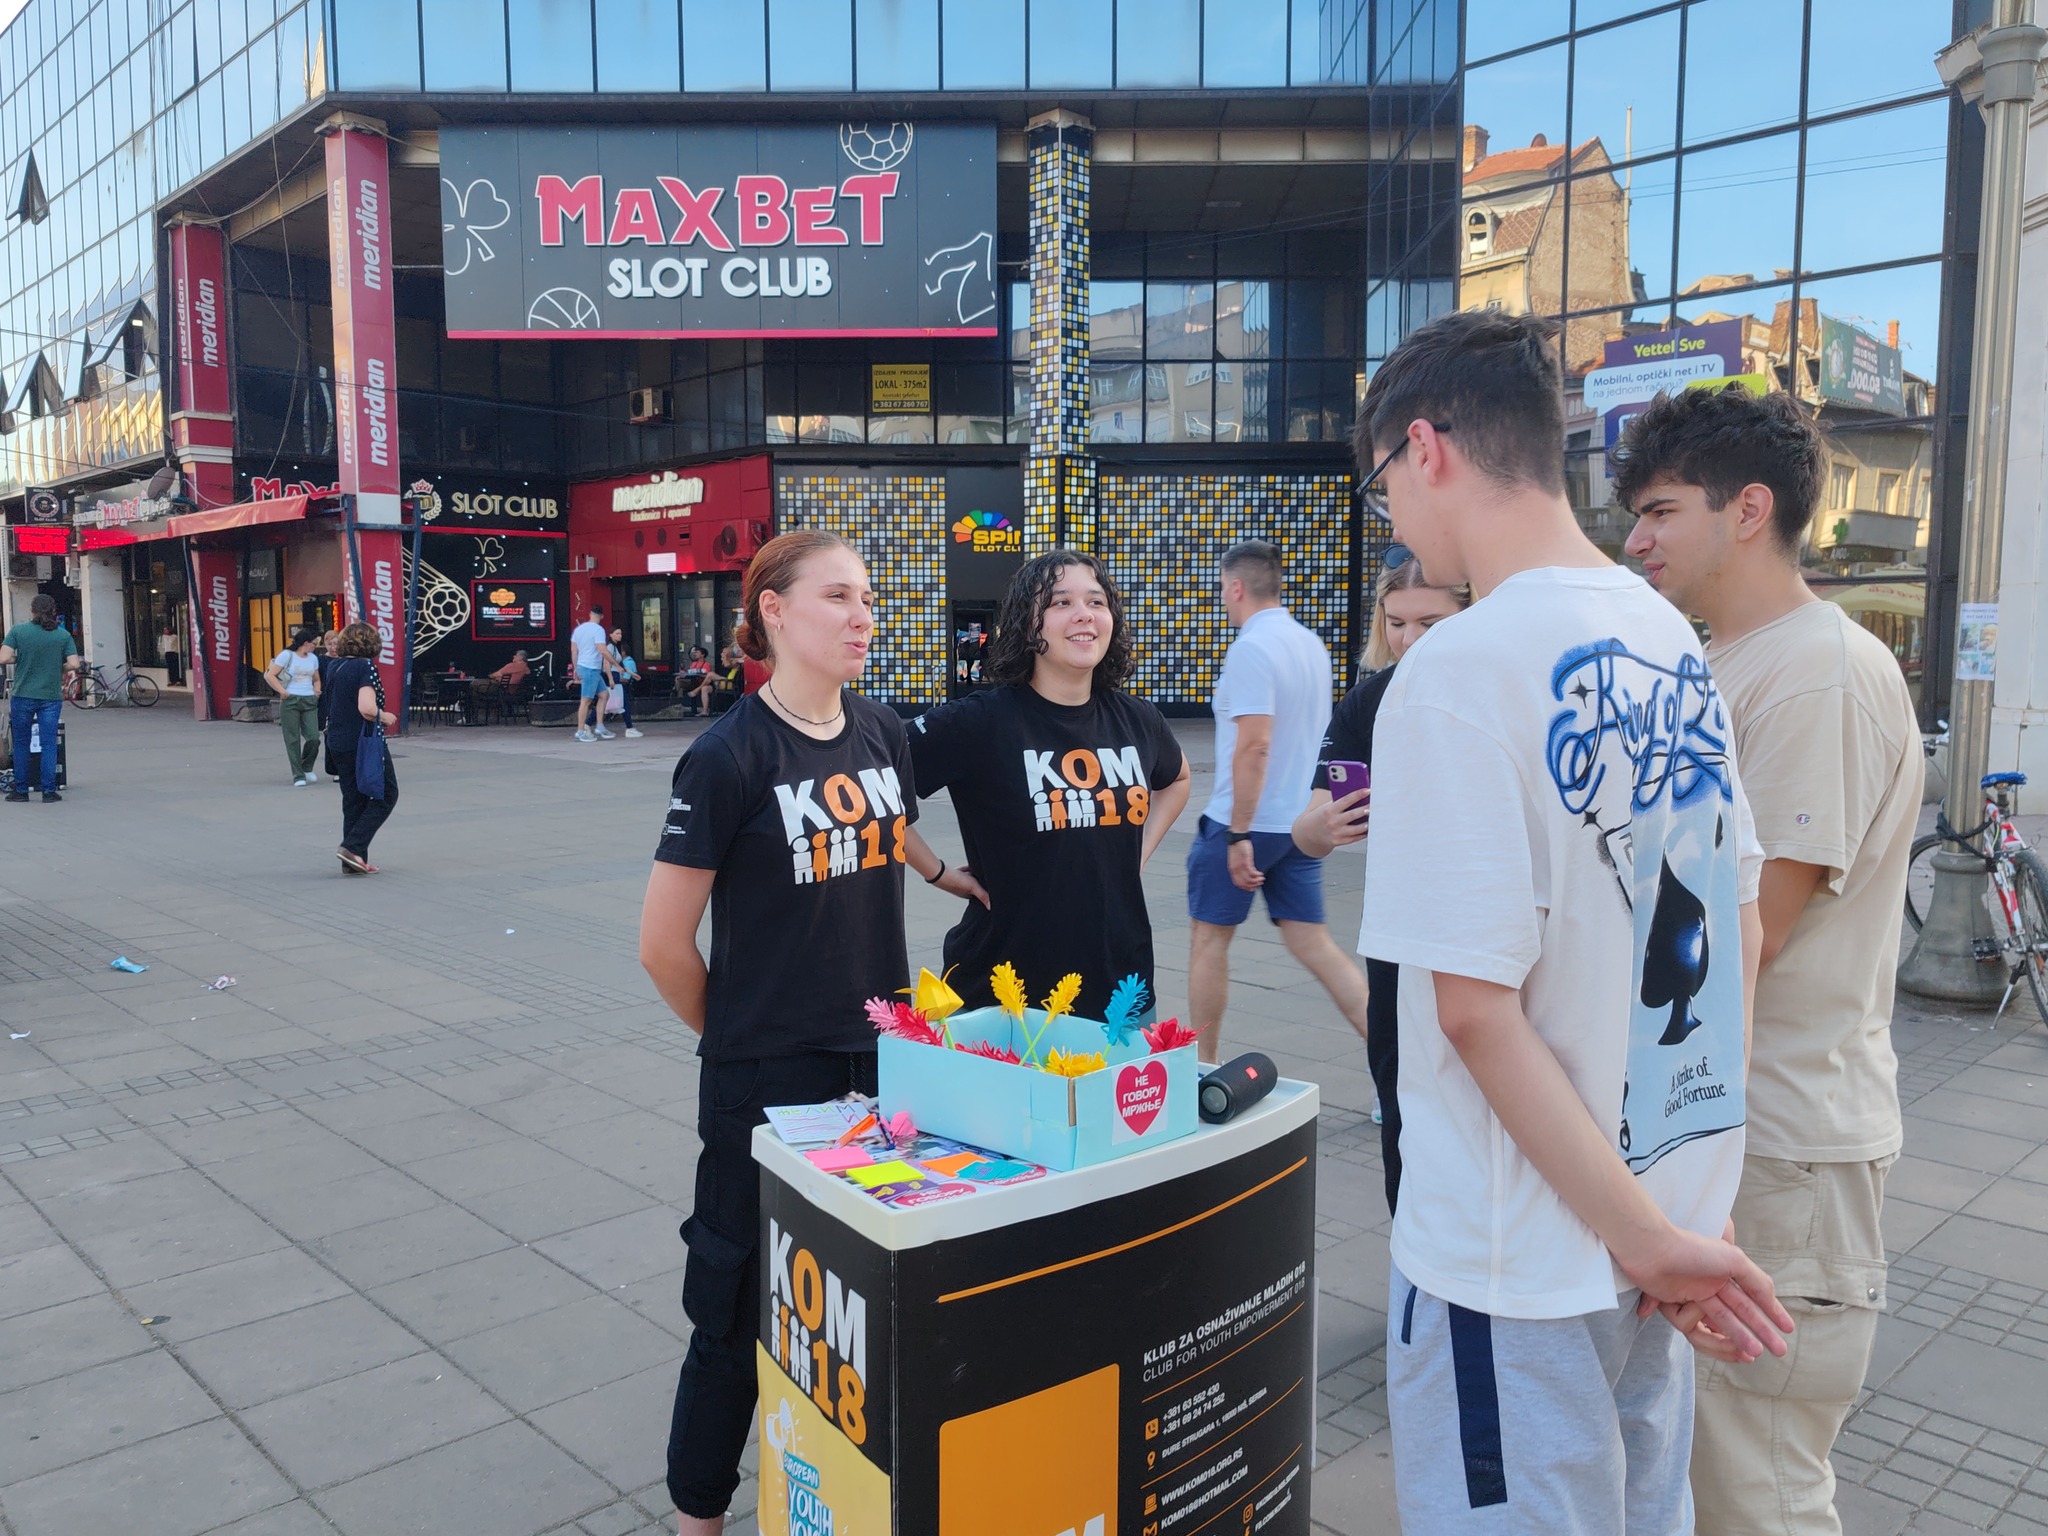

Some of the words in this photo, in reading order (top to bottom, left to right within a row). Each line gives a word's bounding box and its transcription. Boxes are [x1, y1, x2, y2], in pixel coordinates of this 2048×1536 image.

[330, 179, 345, 288] meridian
[355, 179, 381, 291] meridian
[535, 172, 900, 252] MAXBET
[607, 257, 709, 299] SLOT
[721, 256, 833, 299] CLUB
[176, 278, 188, 367] meridian
[196, 278, 218, 368] meridian
[1633, 339, 1675, 358] Yettel
[1679, 337, 1706, 352] Sve
[875, 380, 898, 389] LOKAL
[903, 380, 927, 389] 375m2
[1592, 389, 1605, 399] na
[1605, 380, 1643, 400] jednom
[1593, 373, 1634, 388] Mobilni,
[1636, 365, 1672, 384] optički
[1675, 367, 1692, 377] net
[1701, 363, 1716, 373] TV
[337, 358, 351, 464] meridian
[363, 358, 388, 467] meridian
[451, 491, 503, 516] SLOT
[504, 494, 559, 519] CLUB
[612, 471, 704, 512] meridian
[208, 575, 231, 662] meridian
[370, 560, 395, 666] meridian
[1023, 746, 1149, 799] KOM
[774, 766, 906, 846] KOM
[1134, 1074, 1149, 1088] НЕ
[1696, 1056, 1713, 1078] of
[1122, 1084, 1161, 1105] ГОВОРУ
[1122, 1098, 1162, 1118] МРЖЊЕ
[1683, 1083, 1727, 1107] Fortune
[770, 1217, 866, 1391] KOM
[1142, 1359, 1173, 1383] CLUB
[1176, 1346, 1197, 1368] FOR
[1200, 1327, 1232, 1355] YOUTH
[1234, 1286, 1294, 1336] EMPOWERMENT
[1294, 1276, 1305, 1295] 018
[1143, 1339, 1176, 1366] KLUB
[1179, 1331, 1194, 1350] ZA
[1196, 1294, 1262, 1340] OSNAŽIVANJE
[1263, 1270, 1294, 1302] MLADIH
[1294, 1260, 1306, 1280] 018
[1162, 1404, 1181, 1422] +381
[1207, 1382, 1220, 1397] 430
[1162, 1418, 1181, 1435] +381
[1192, 1406, 1202, 1420] 24
[1202, 1400, 1212, 1414] 74
[1181, 1421, 1216, 1448] STRUGARA
[1160, 1464, 1249, 1530] KOM018@HOTMAIL.COM
[1161, 1446, 1244, 1506] WWW.KOM018.ORG.RS
[788, 1480, 833, 1536] YOUTH
